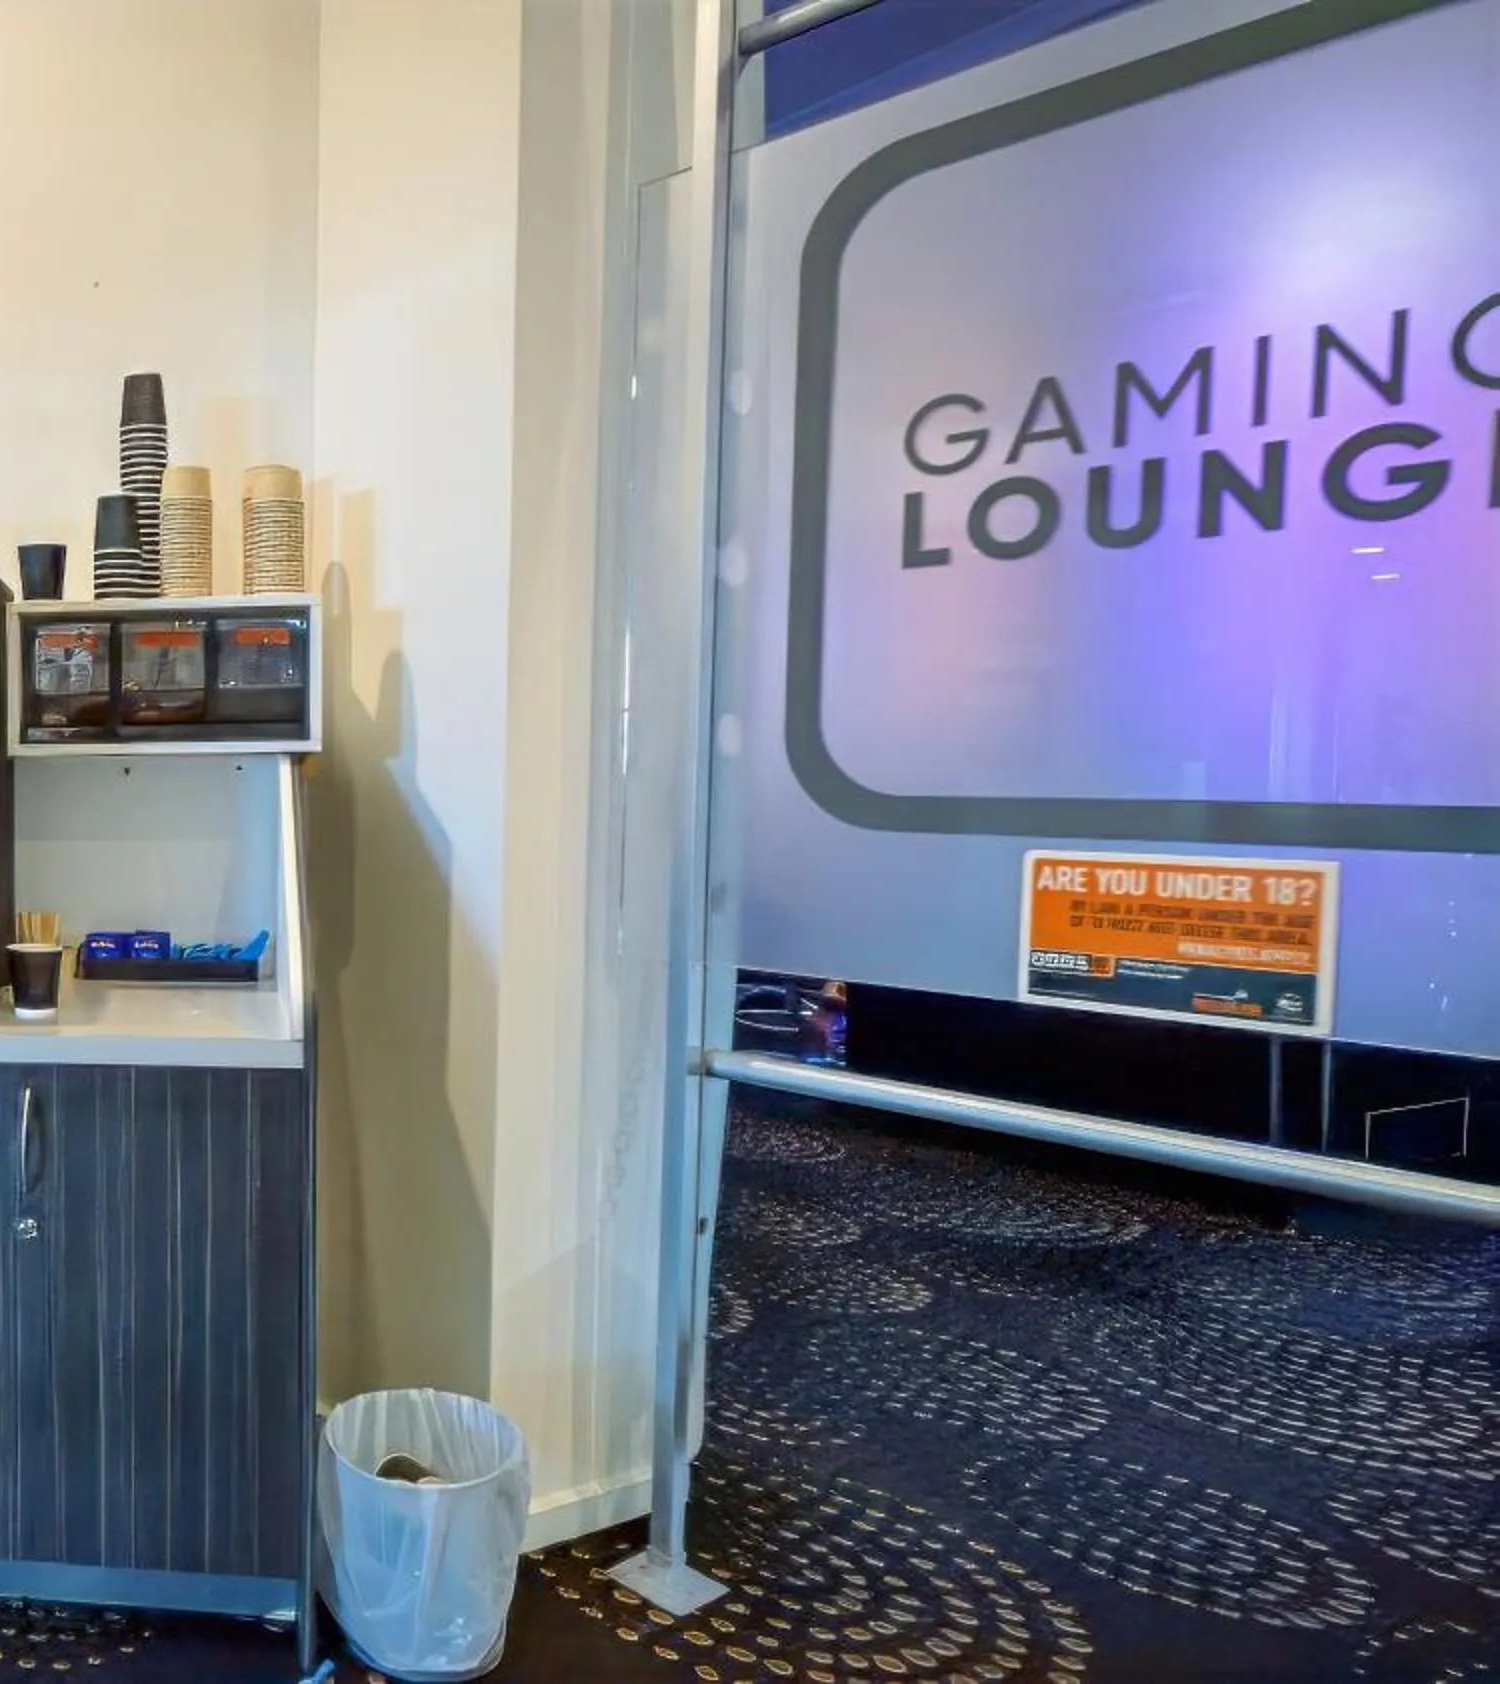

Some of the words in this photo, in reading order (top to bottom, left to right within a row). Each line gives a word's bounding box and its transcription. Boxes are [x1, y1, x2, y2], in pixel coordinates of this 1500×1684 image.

[901, 409, 1500, 569] LOUNG
[1036, 865, 1089, 893] ARE
[1093, 867, 1148, 897] YOU
[1155, 870, 1253, 902] UNDER
[1263, 876, 1318, 907] 18?
